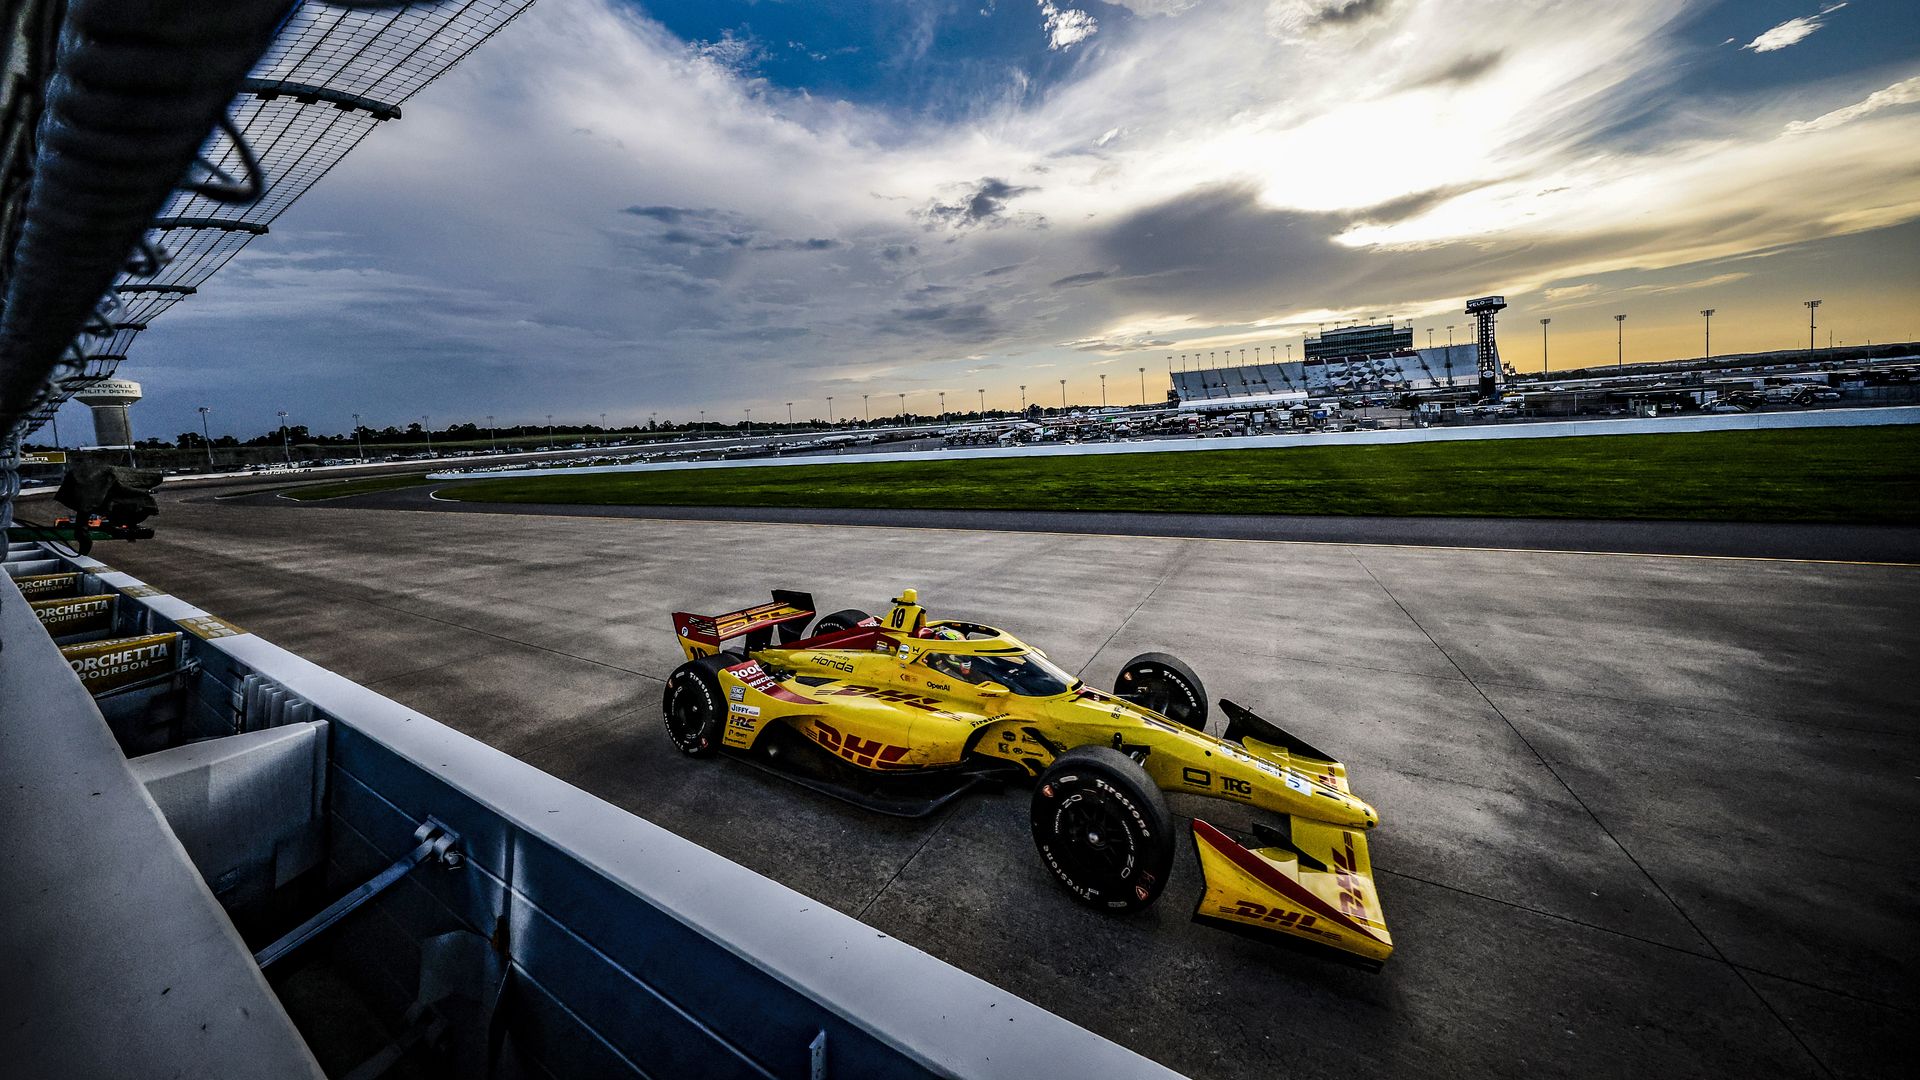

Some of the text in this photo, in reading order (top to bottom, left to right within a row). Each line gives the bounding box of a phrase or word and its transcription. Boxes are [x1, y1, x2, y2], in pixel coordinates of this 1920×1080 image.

[892, 607, 906, 629] 10
[810, 656, 854, 673] Honda
[926, 681, 951, 691] OpenAI
[1162, 670, 1197, 708] Firestone
[970, 712, 1011, 728] Firestone
[814, 719, 925, 770] DHL
[1219, 776, 1252, 794] TRG
[1095, 779, 1151, 838] Firestone
[1235, 900, 1324, 935] DHL
